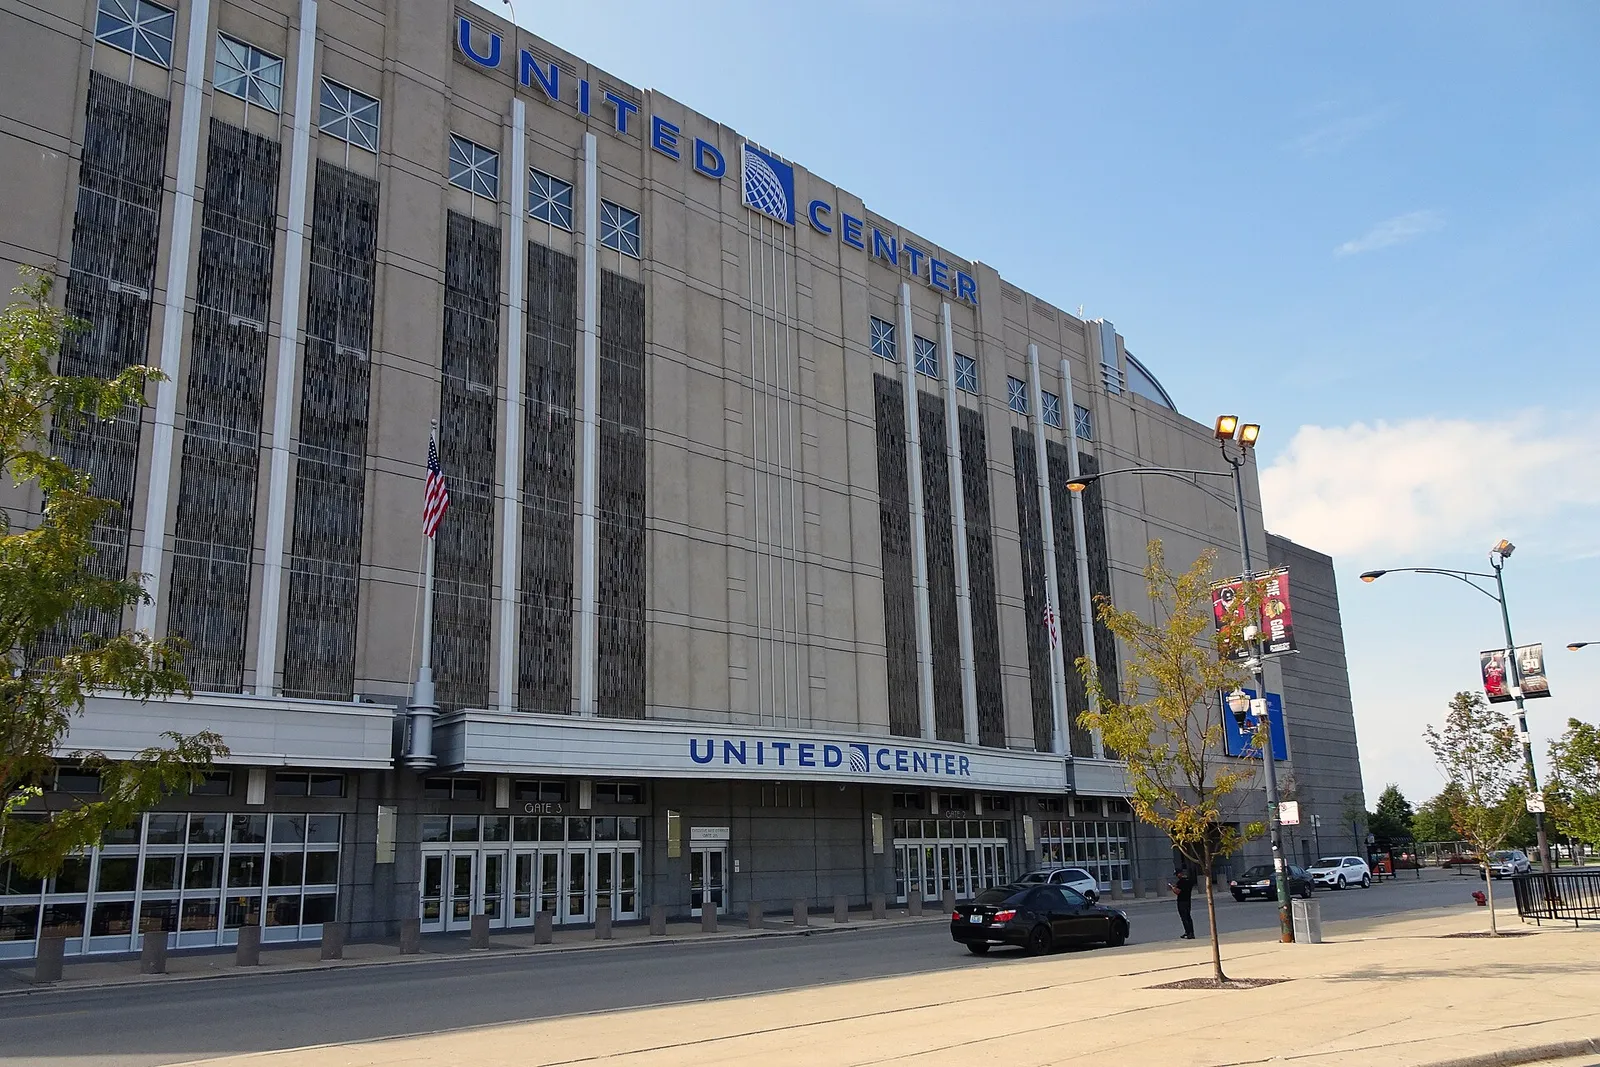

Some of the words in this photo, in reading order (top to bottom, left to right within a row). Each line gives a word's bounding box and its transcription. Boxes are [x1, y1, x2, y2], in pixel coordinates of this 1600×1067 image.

[457, 17, 726, 179] UNITED
[807, 199, 979, 306] CENTER
[1270, 618, 1285, 642] GOAL
[689, 738, 843, 768] UNITED
[875, 748, 971, 776] CENTER
[524, 802, 552, 814] GATE
[555, 803, 563, 814] 3
[945, 810, 961, 819] GATE
